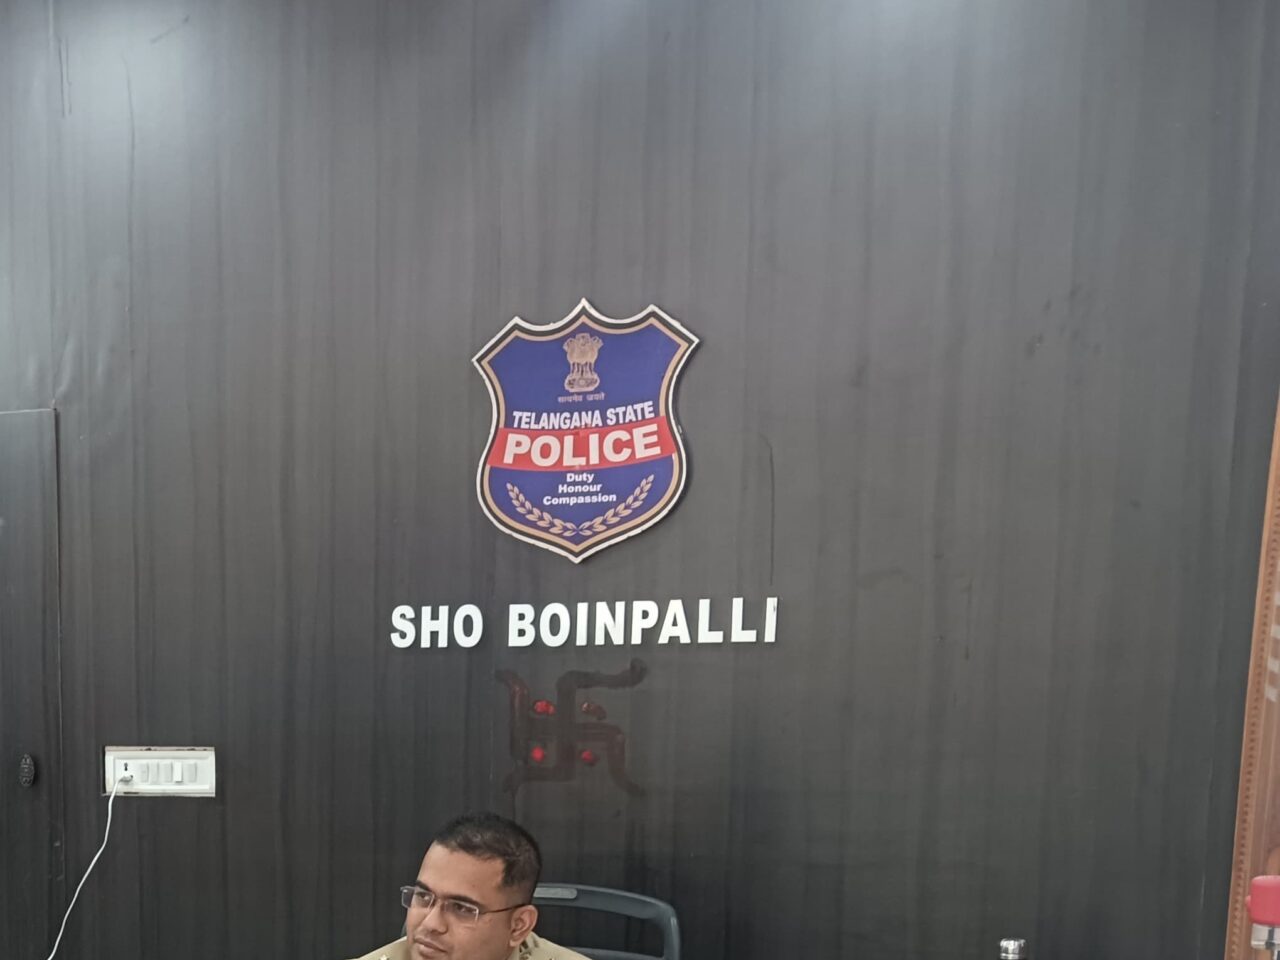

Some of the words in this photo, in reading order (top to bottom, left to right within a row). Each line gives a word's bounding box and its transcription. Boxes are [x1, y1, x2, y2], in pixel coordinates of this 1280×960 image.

[513, 410, 602, 430] TELANGANA
[606, 401, 655, 426] STATE
[503, 423, 661, 467] POLICE
[558, 483, 602, 494] Honour
[566, 473, 595, 483] Duty
[543, 493, 617, 506] Compassion
[390, 603, 484, 649] SHO
[507, 596, 779, 648] BOINPALLI
